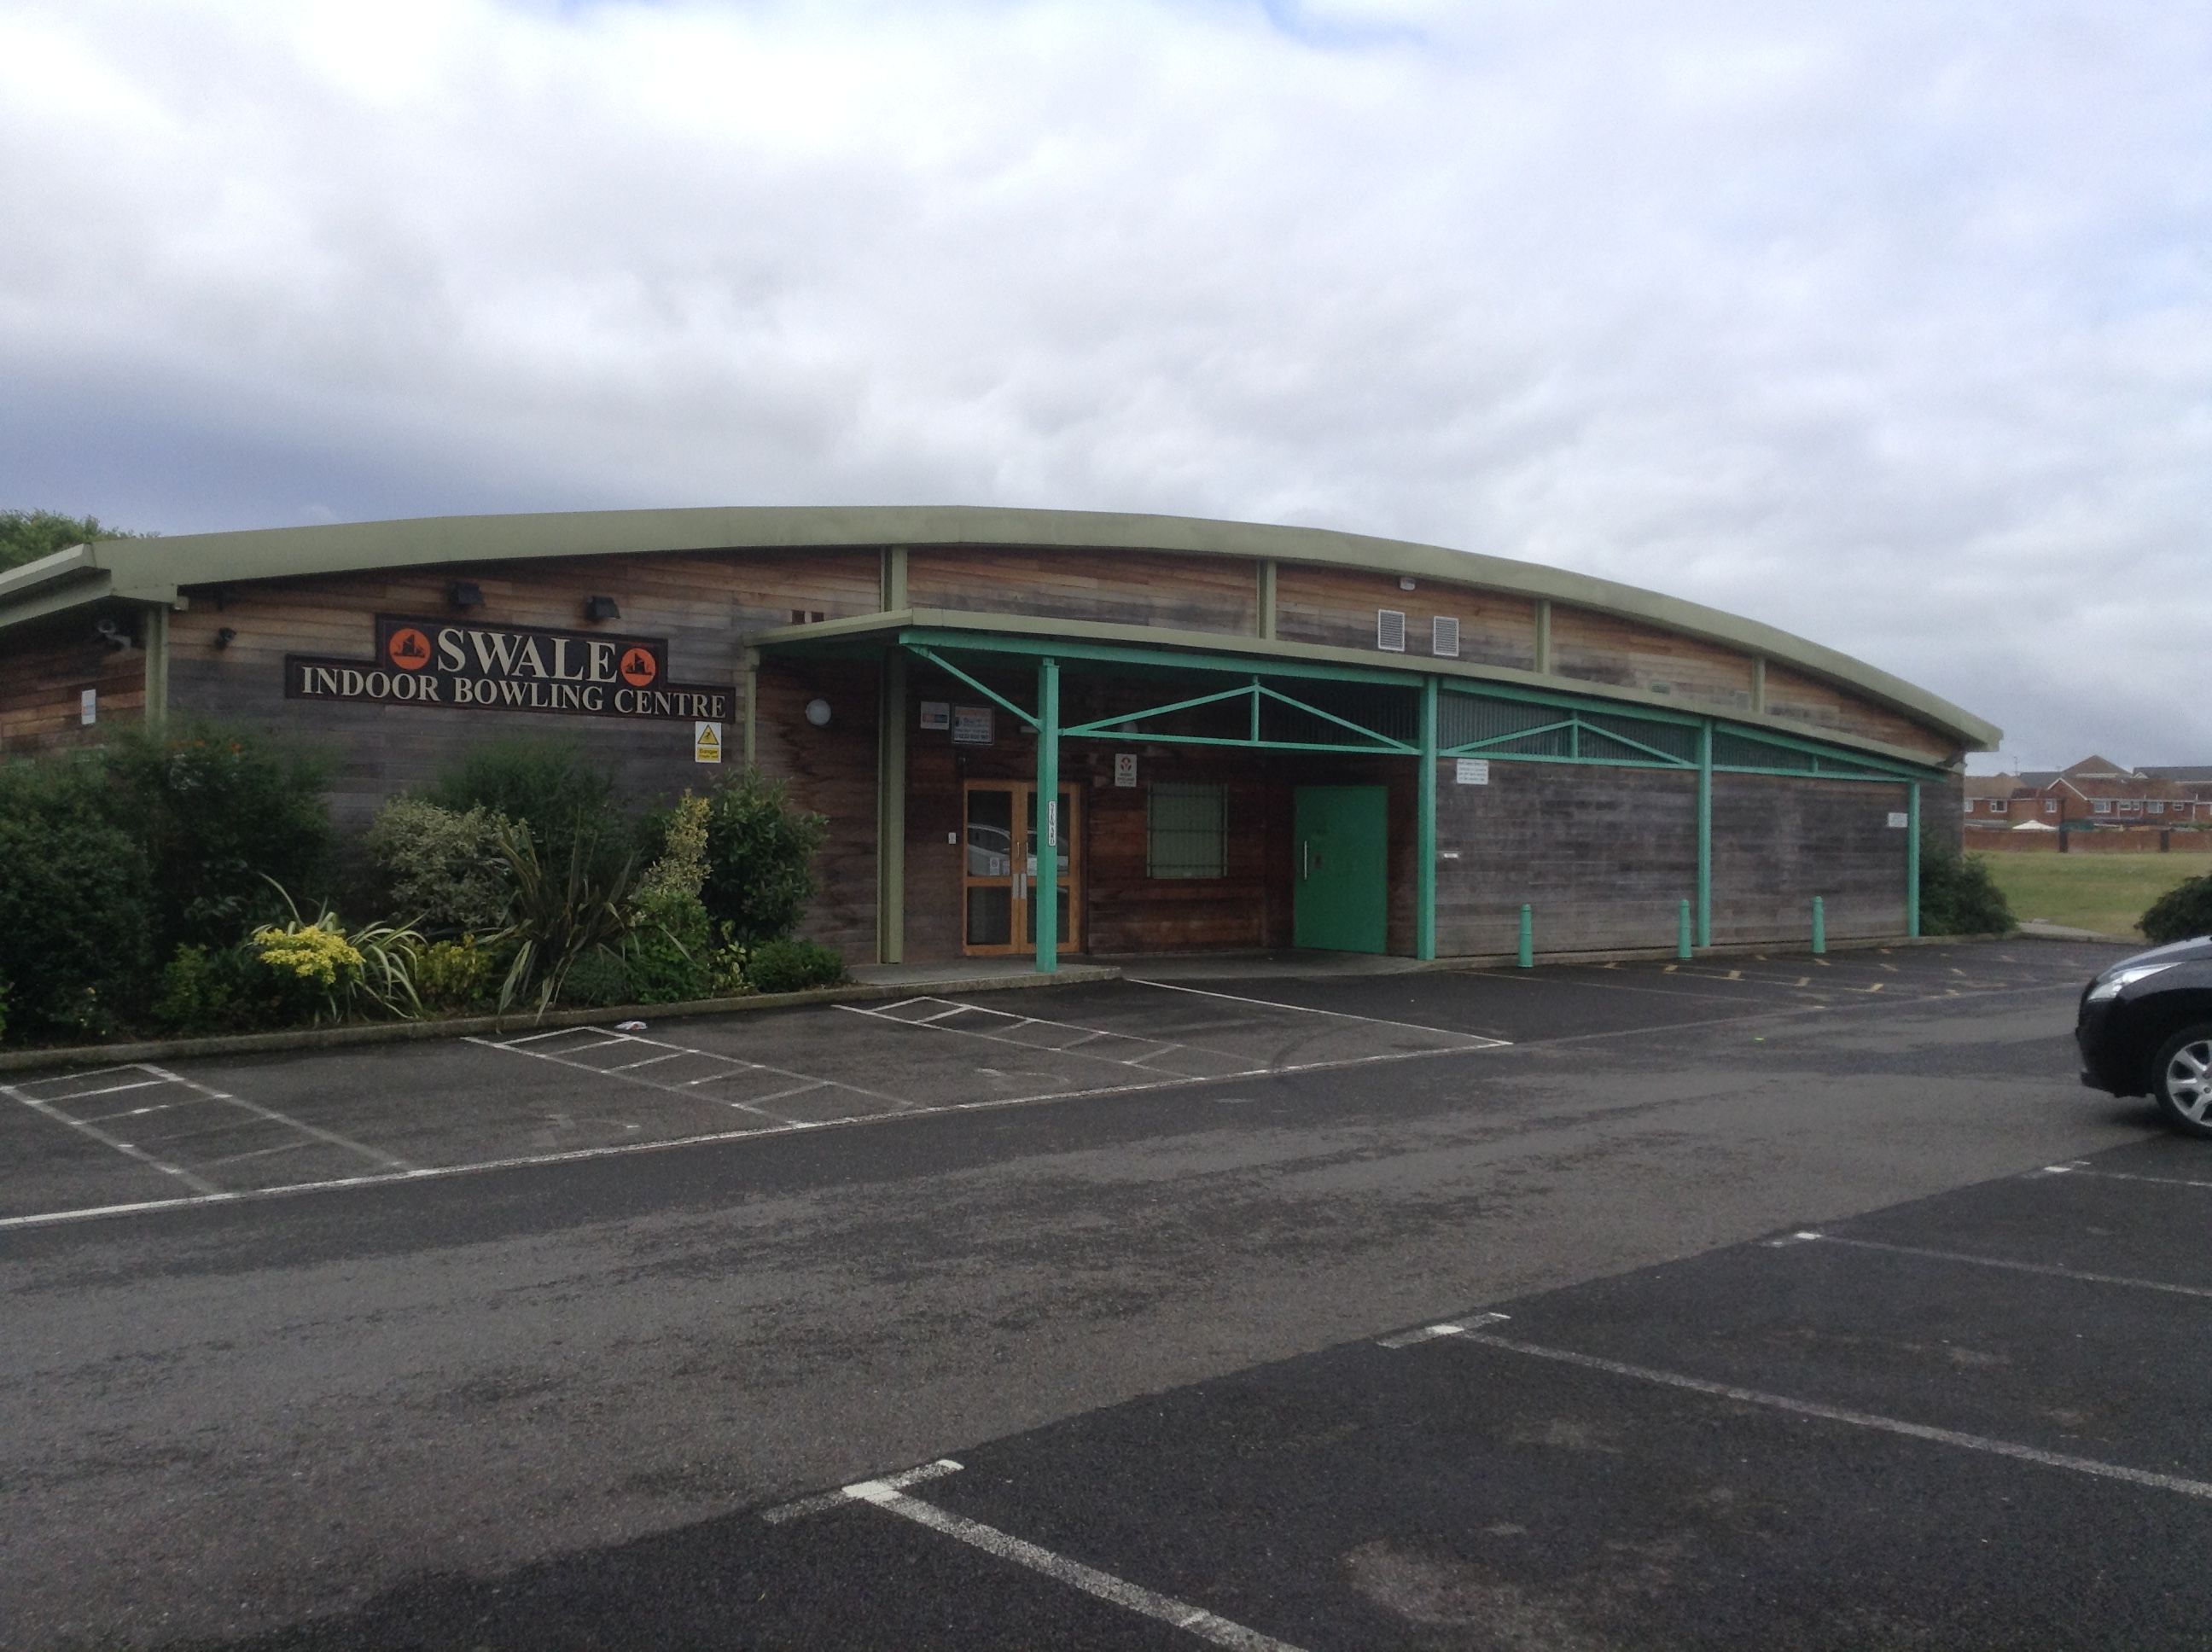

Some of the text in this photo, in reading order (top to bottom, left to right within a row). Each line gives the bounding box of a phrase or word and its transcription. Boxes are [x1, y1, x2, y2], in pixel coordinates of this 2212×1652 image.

[437, 628, 618, 683] SWALE
[302, 666, 726, 718] INDOOR BOWLING CENTRE
